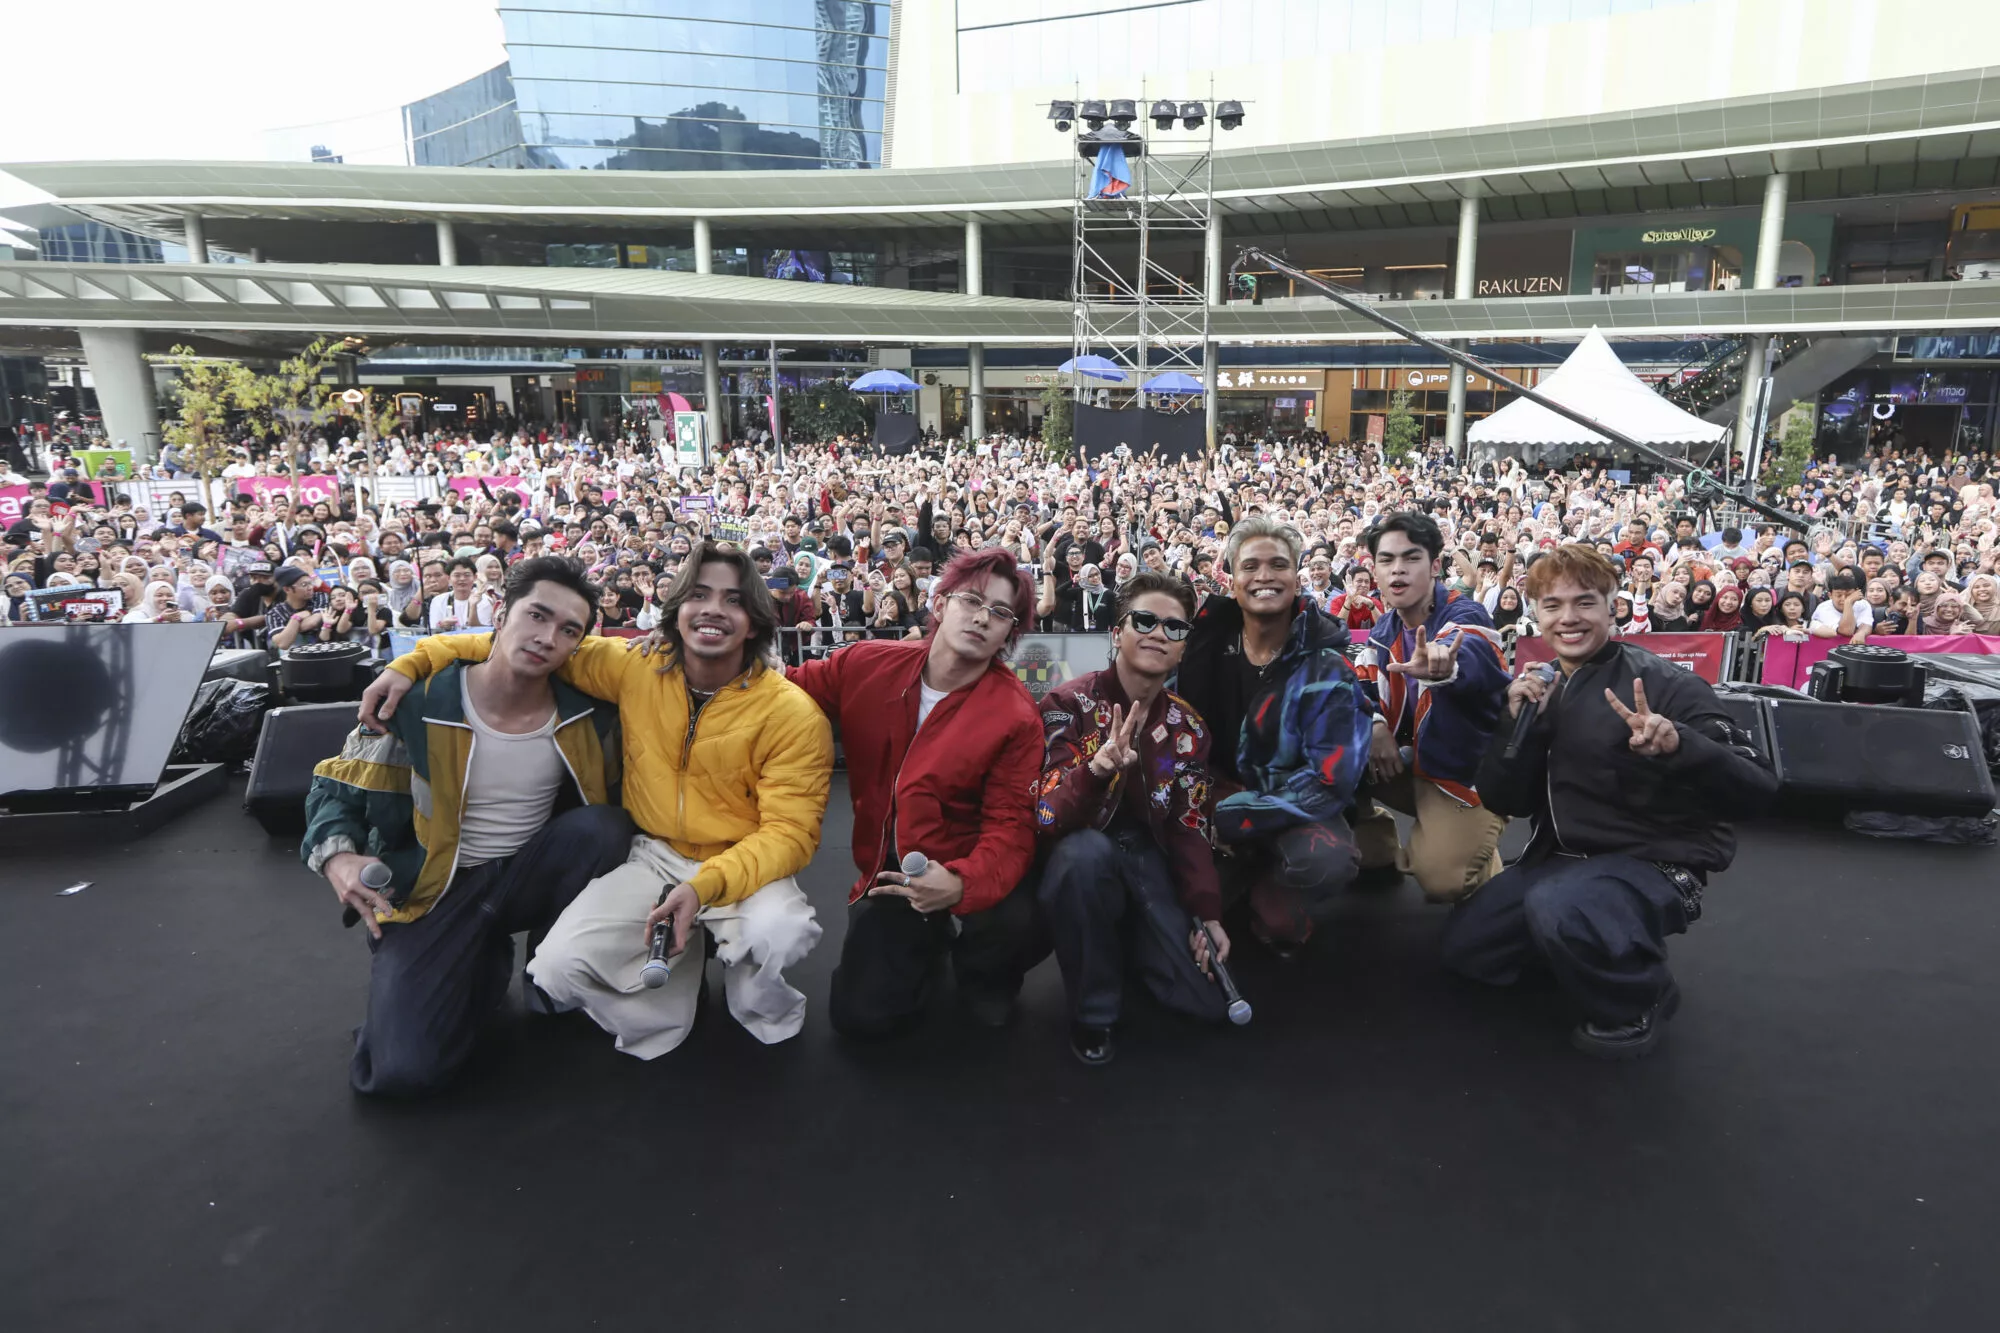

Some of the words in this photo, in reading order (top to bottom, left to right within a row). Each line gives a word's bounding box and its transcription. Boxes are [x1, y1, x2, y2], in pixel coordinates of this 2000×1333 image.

[1479, 277, 1563, 294] RAKUZEN
[1426, 374, 1475, 383] IPPO
[1086, 737, 1098, 755] N
